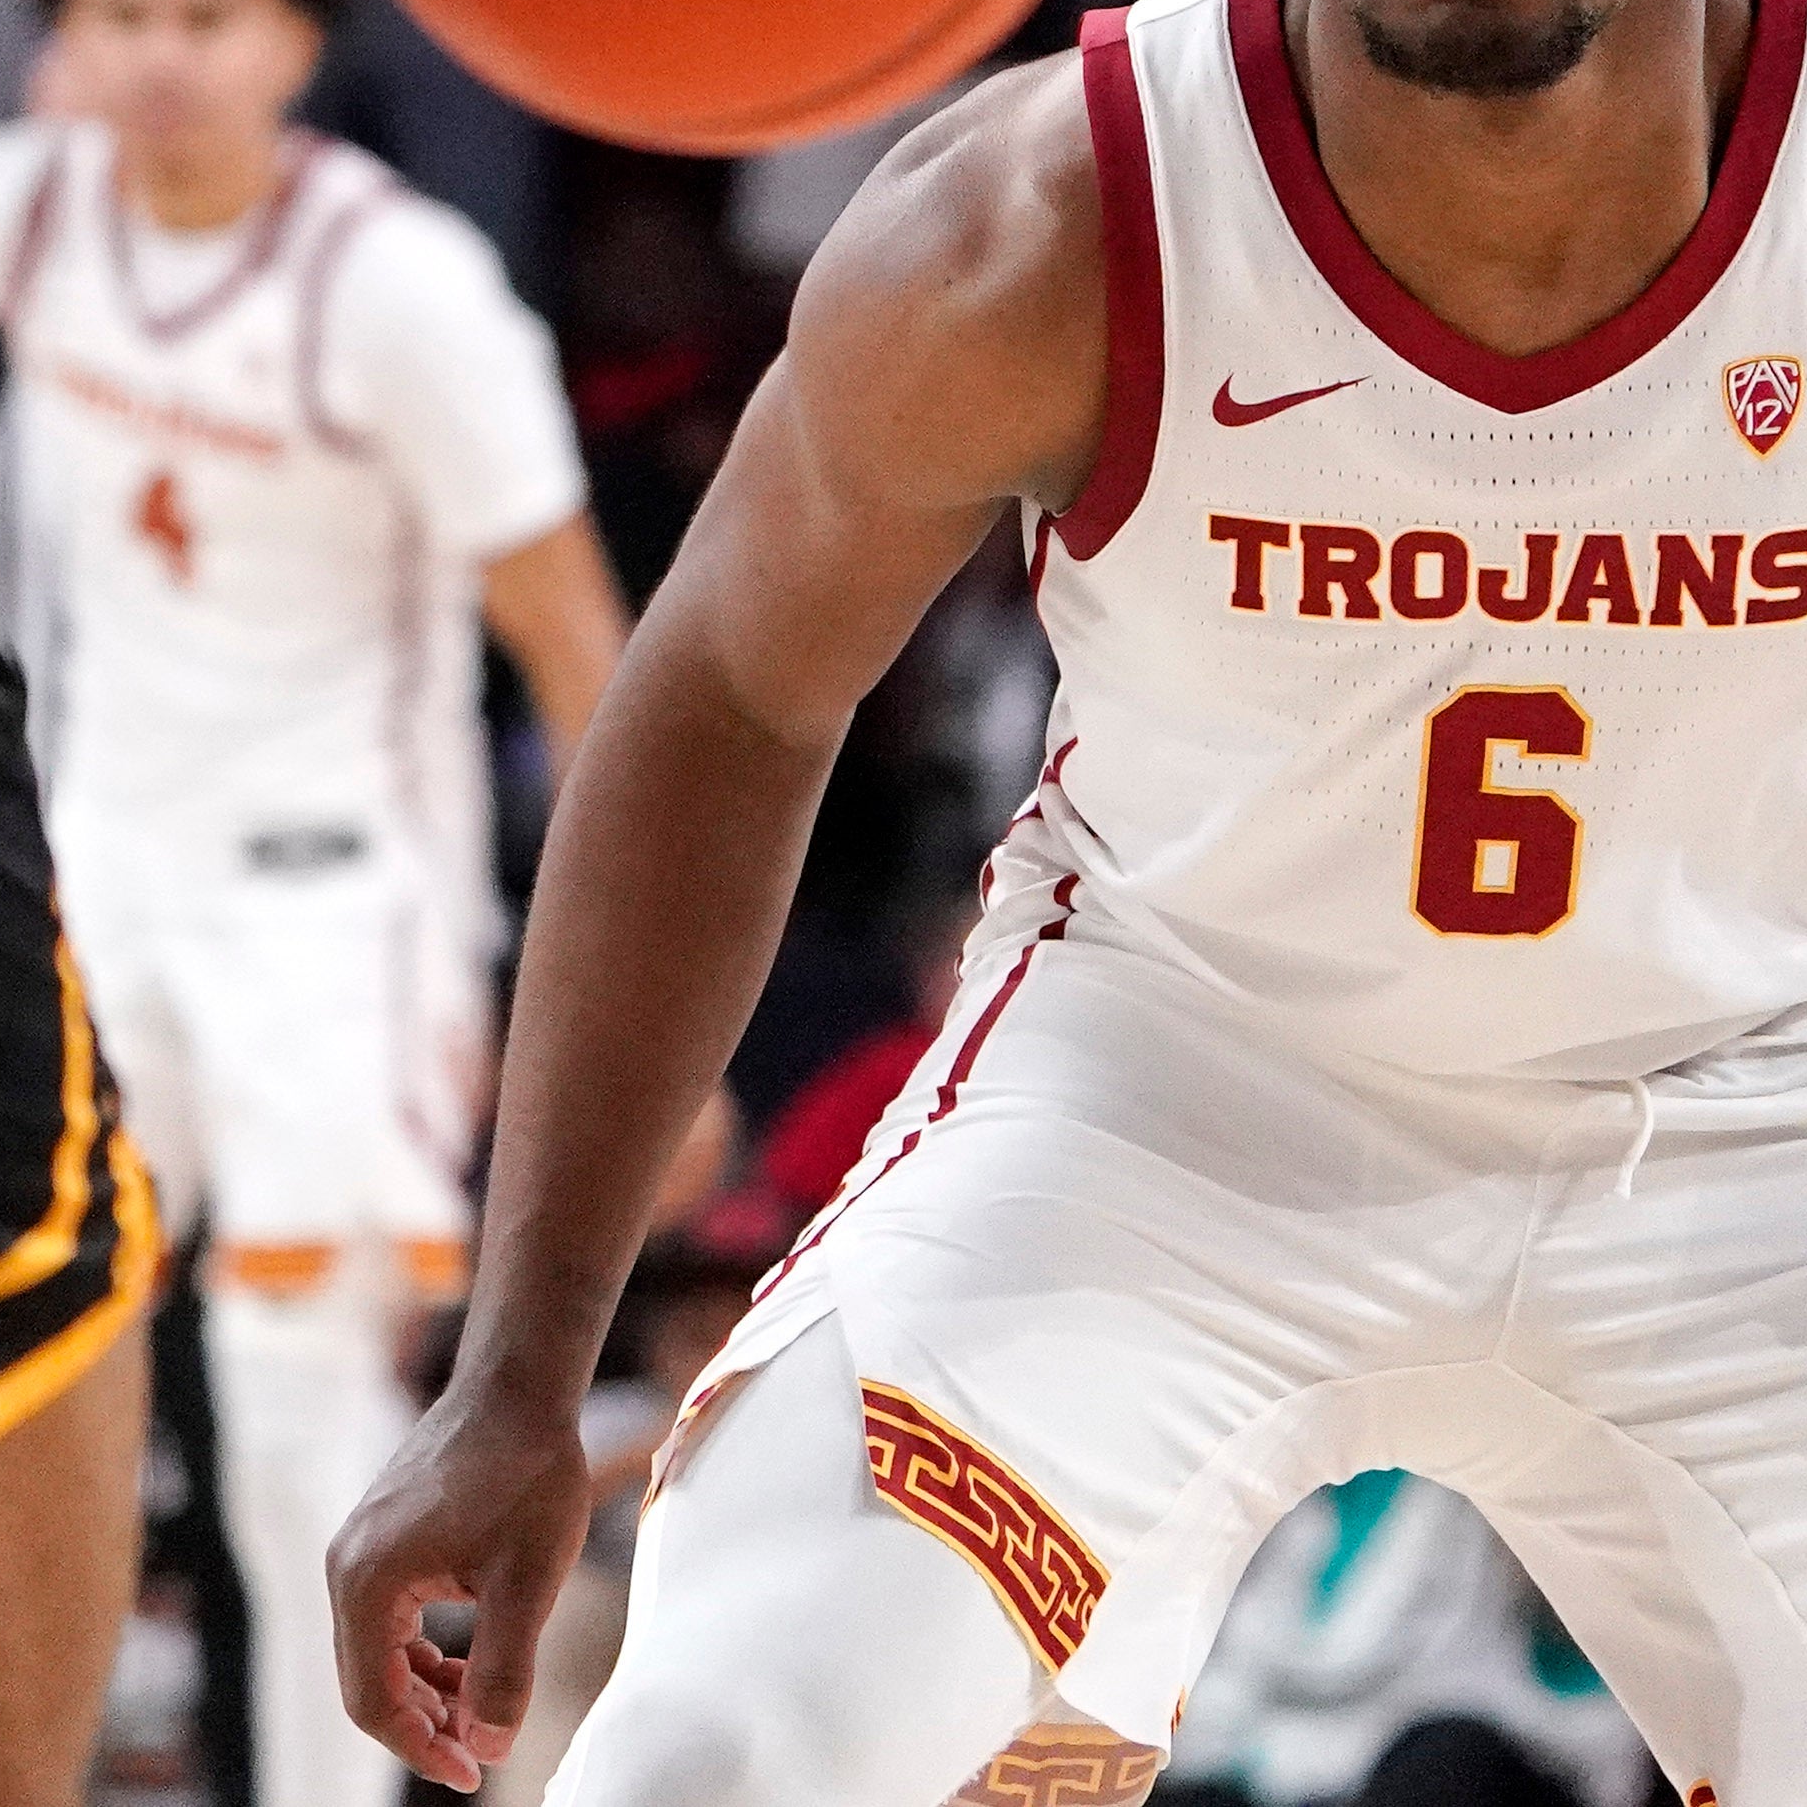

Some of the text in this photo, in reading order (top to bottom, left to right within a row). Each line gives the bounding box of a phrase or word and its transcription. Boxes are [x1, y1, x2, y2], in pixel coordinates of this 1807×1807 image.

[1727, 359, 1799, 420] PAC
[1745, 397, 1782, 436] 12
[1408, 683, 1595, 941] 6
